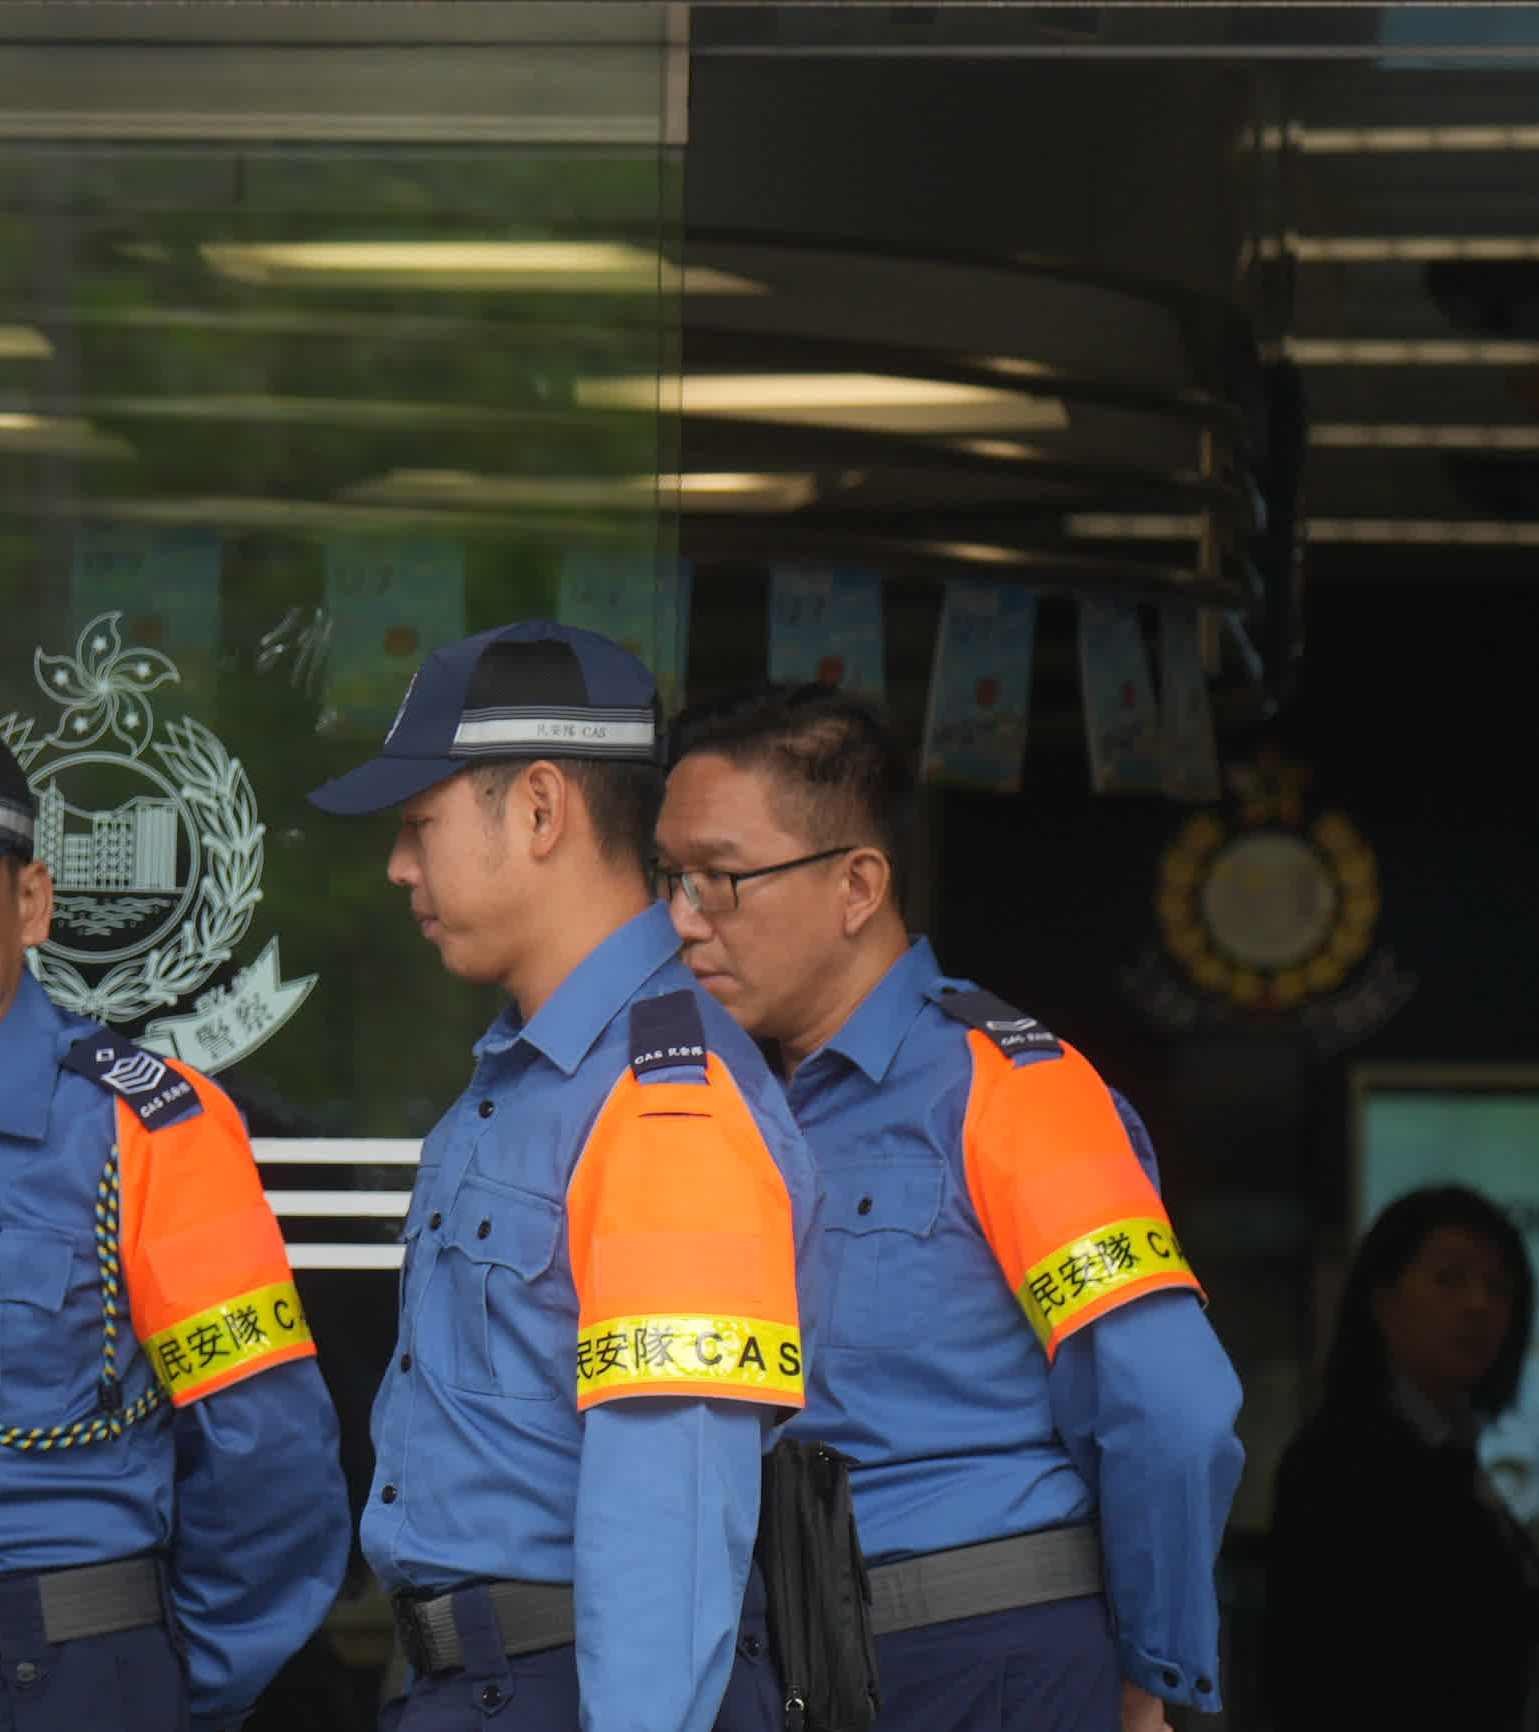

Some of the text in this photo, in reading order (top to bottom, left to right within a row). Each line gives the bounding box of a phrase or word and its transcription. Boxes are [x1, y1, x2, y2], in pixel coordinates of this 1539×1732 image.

[1028, 1232, 1141, 1319] 民安隊
[157, 1305, 268, 1383] 民安隊
[696, 1331, 802, 1377] CAS
